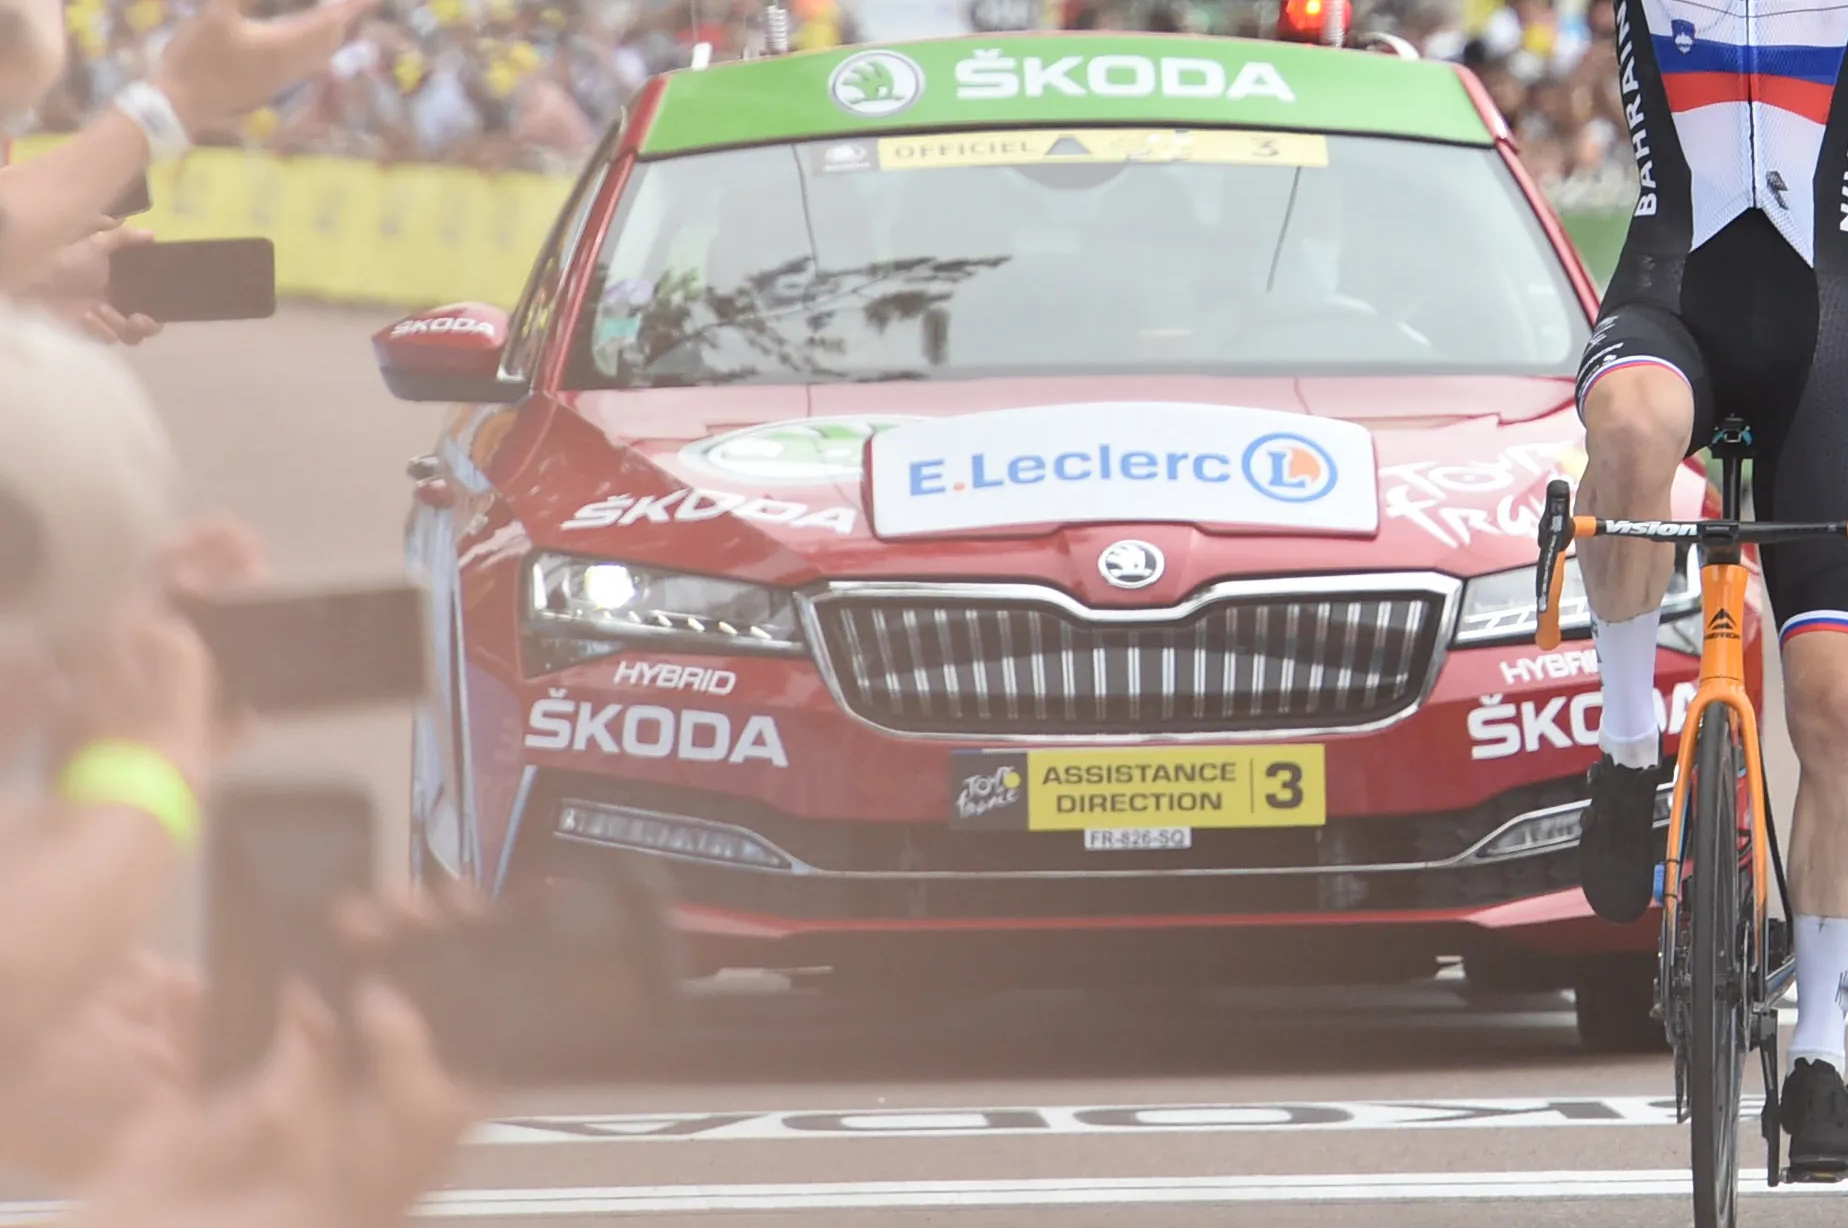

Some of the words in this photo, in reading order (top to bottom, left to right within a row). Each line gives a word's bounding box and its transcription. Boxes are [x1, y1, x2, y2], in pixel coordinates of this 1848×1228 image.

[954, 48, 1297, 103] ŠKODA
[893, 138, 1039, 160] OFFICIEL
[1251, 136, 1281, 158] 3
[909, 444, 1231, 496] E.Leclerc
[561, 487, 859, 535] ŠKODA
[613, 660, 737, 697] HYBRID
[1499, 648, 1599, 685] HYBRI
[524, 687, 790, 769] ŠKODA
[1042, 762, 1237, 785] ASSISTANCE
[1264, 761, 1304, 809] 3
[1056, 792, 1223, 814] DIRECTION
